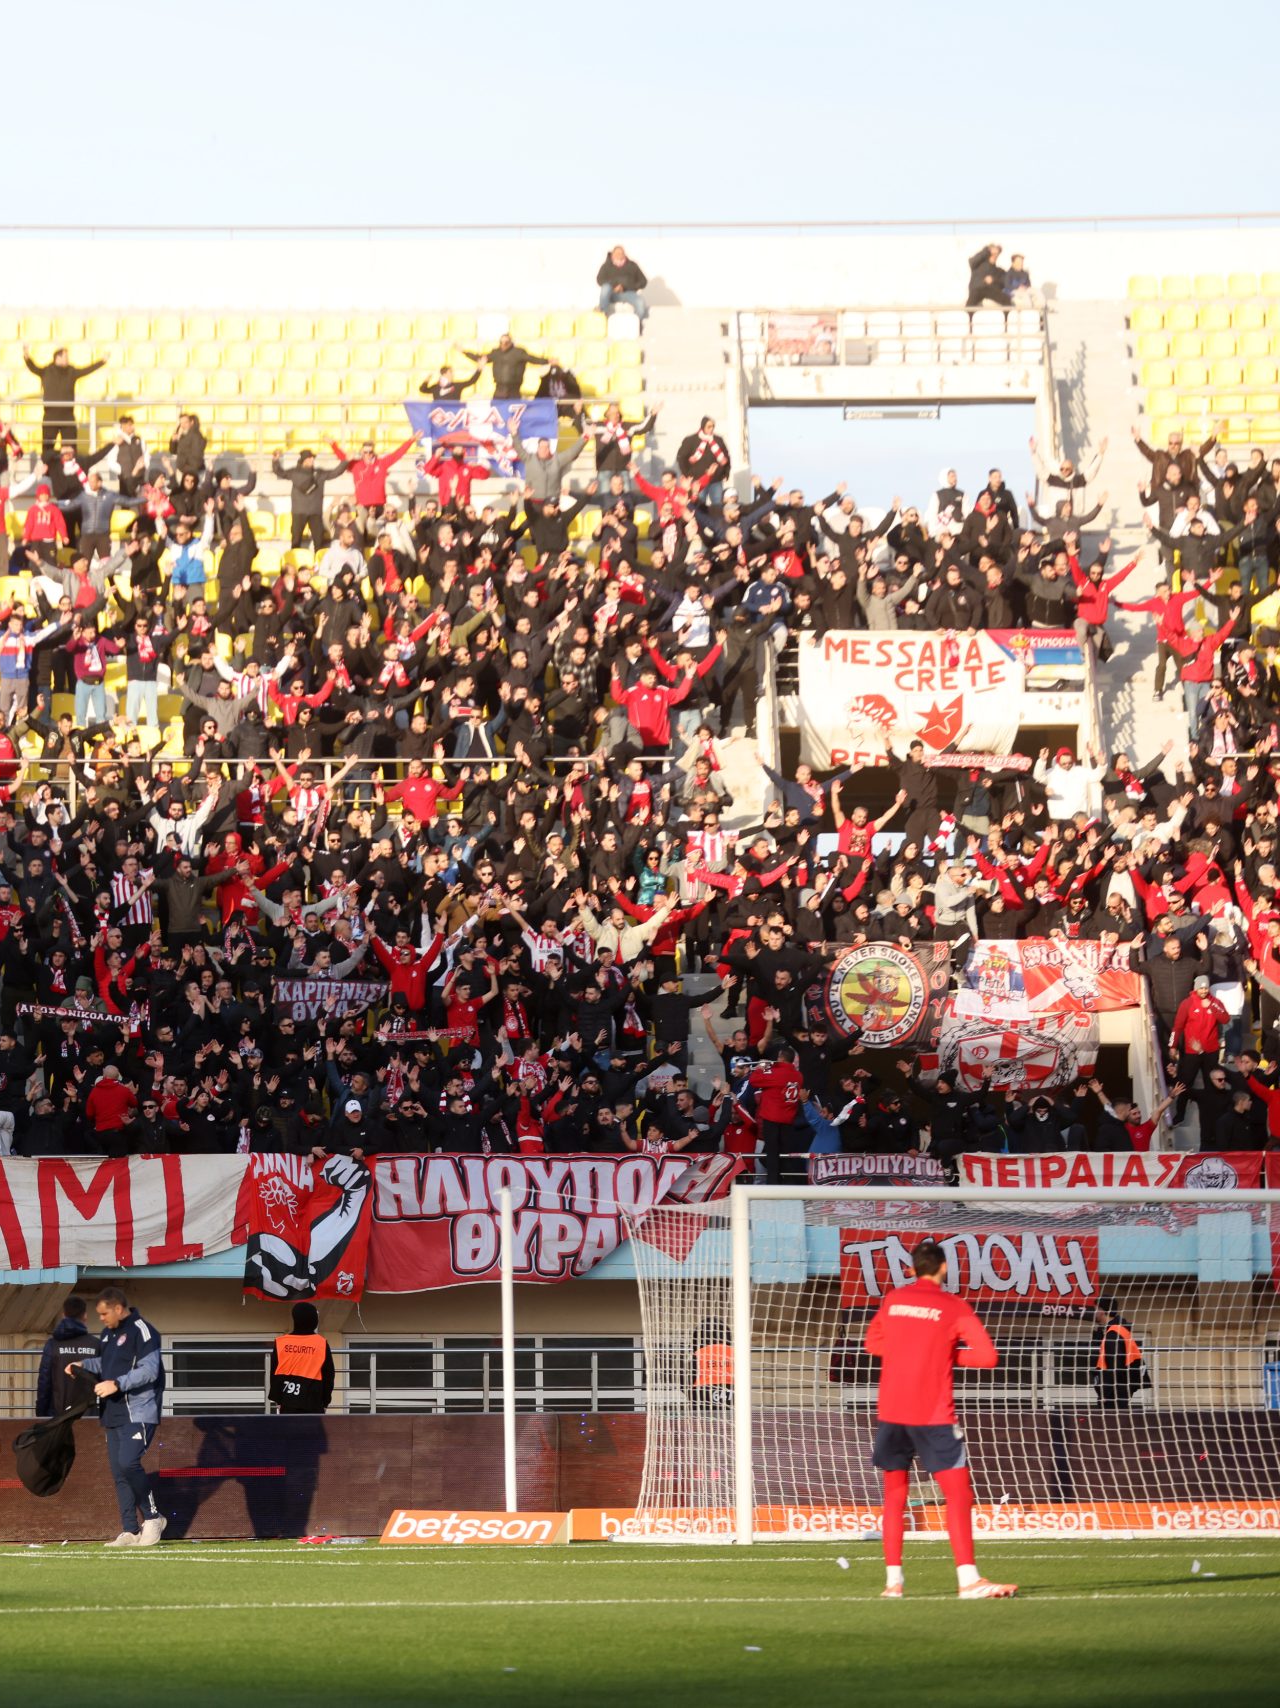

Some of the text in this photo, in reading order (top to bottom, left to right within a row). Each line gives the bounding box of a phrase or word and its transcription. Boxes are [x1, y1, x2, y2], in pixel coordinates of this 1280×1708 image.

[894, 660, 1006, 692] CRETE
[278, 981, 387, 1001] ΚΑΡΠΕΝΗΣΙ
[838, 947, 876, 973] NEVER
[880, 947, 918, 981] SMOKE
[904, 985, 924, 1027] ALONE
[20, 1003, 56, 1014] ΑΓΟΣ
[862, 1029, 897, 1042] ATE-7
[817, 1155, 943, 1178] ΑΣΠΡΟΠΥΡΓΟΣ
[962, 1153, 1182, 1188] ΠΕΙΡΑΙΑΣ
[1042, 1305, 1074, 1317] ΘΥΡΑ
[77, 1347, 96, 1355] CREW
[284, 1345, 316, 1355] SECURITY
[283, 1381, 301, 1396] 793
[389, 1510, 553, 1544] betsson
[600, 1511, 732, 1538] betsson
[971, 1507, 1099, 1532] betsson
[1152, 1503, 1280, 1531] betsson
